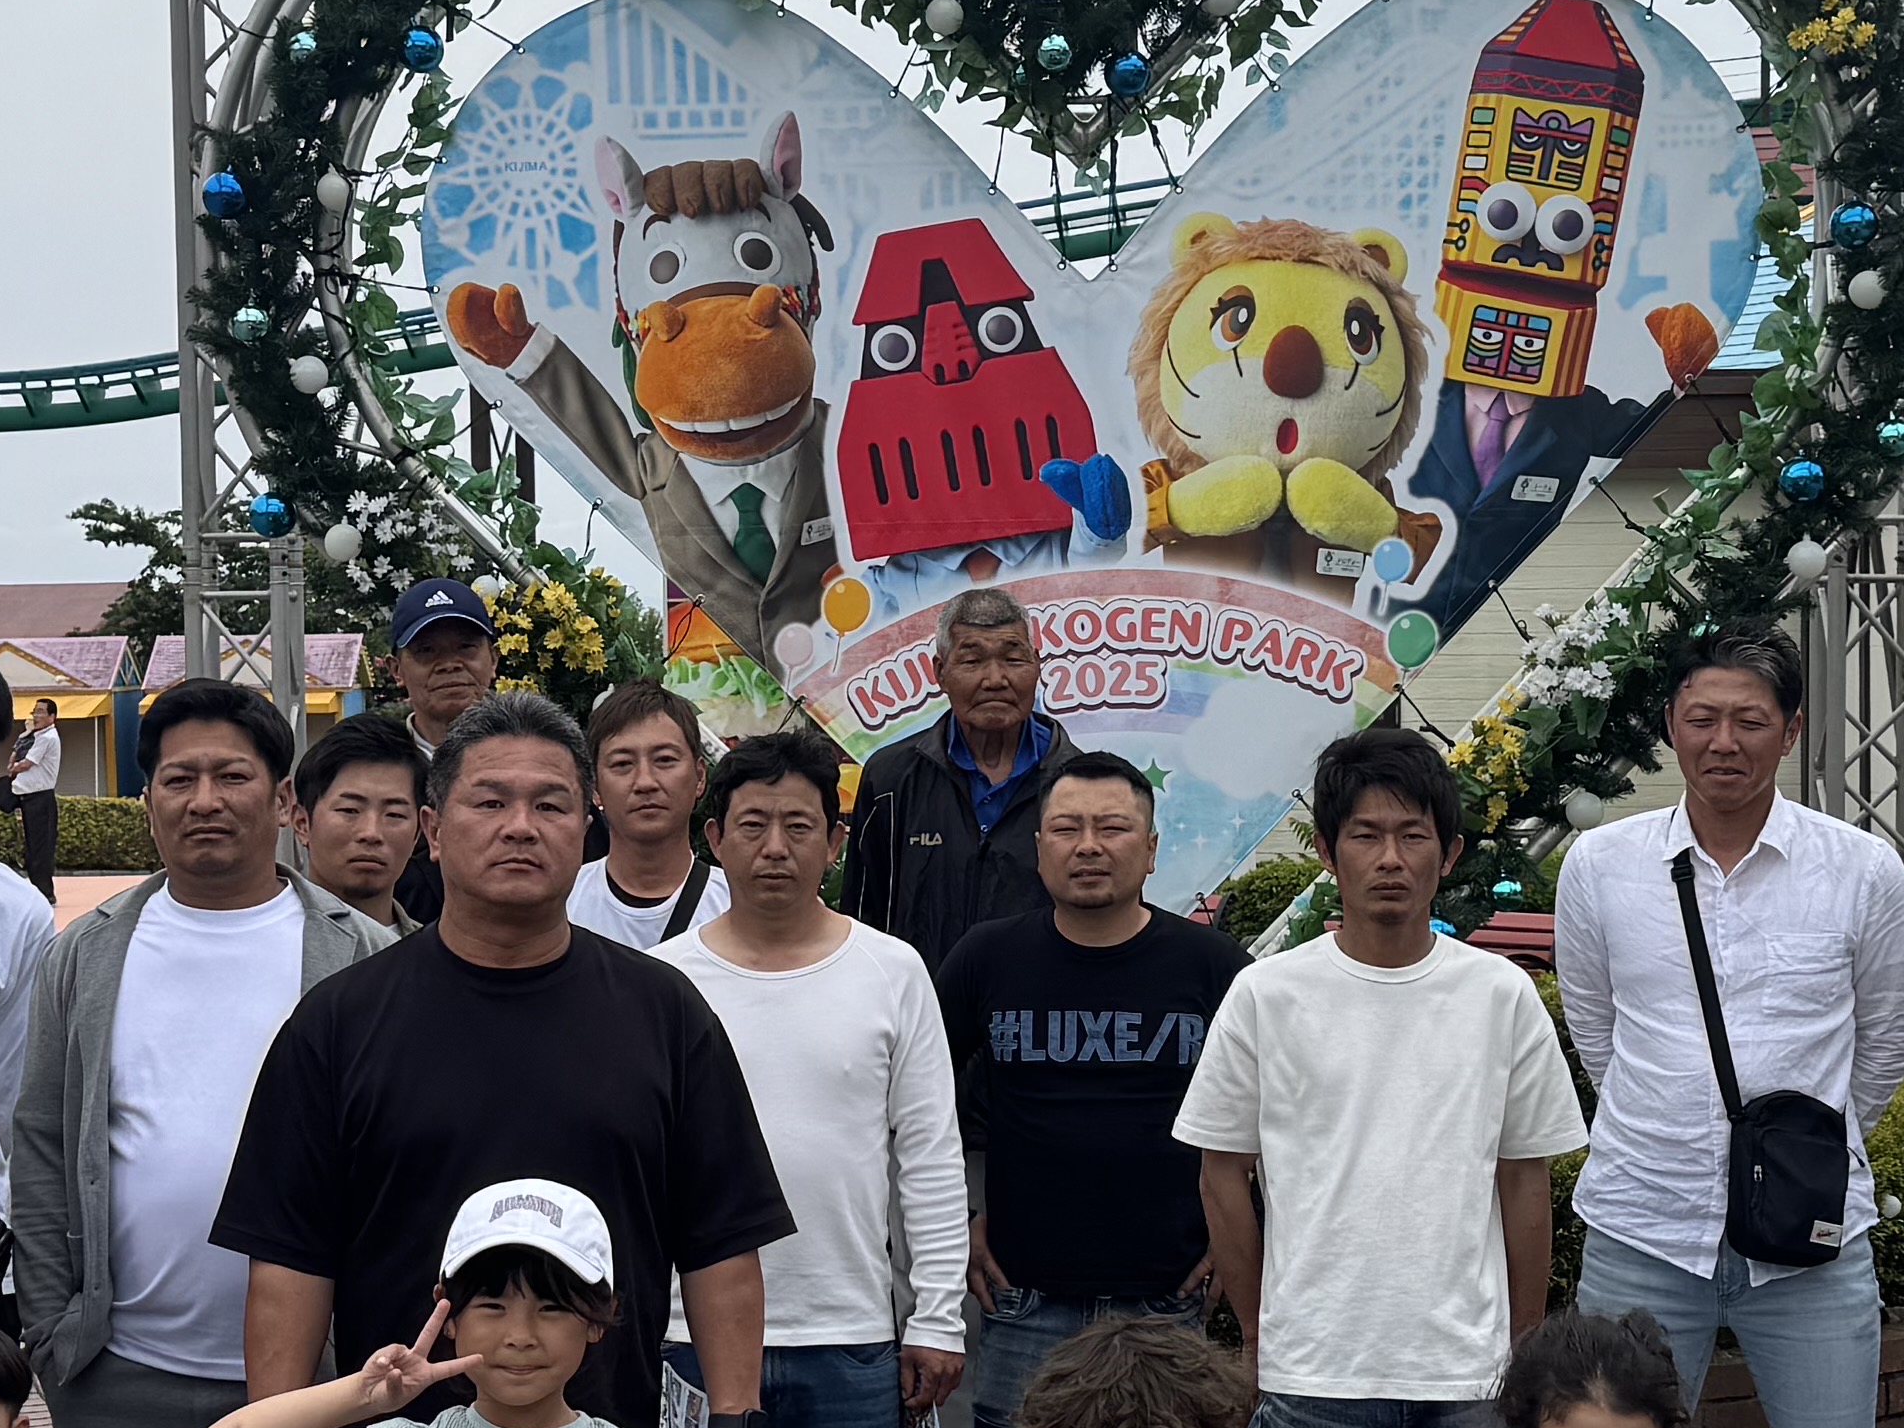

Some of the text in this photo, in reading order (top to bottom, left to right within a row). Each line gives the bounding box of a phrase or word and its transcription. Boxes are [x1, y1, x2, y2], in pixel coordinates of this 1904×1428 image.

[854, 606, 1359, 719] KIJI KOGEN PARK
[1048, 662, 1163, 700] 2025
[909, 832, 943, 846] FILA
[988, 1010, 1205, 1065] #LUXE/R
